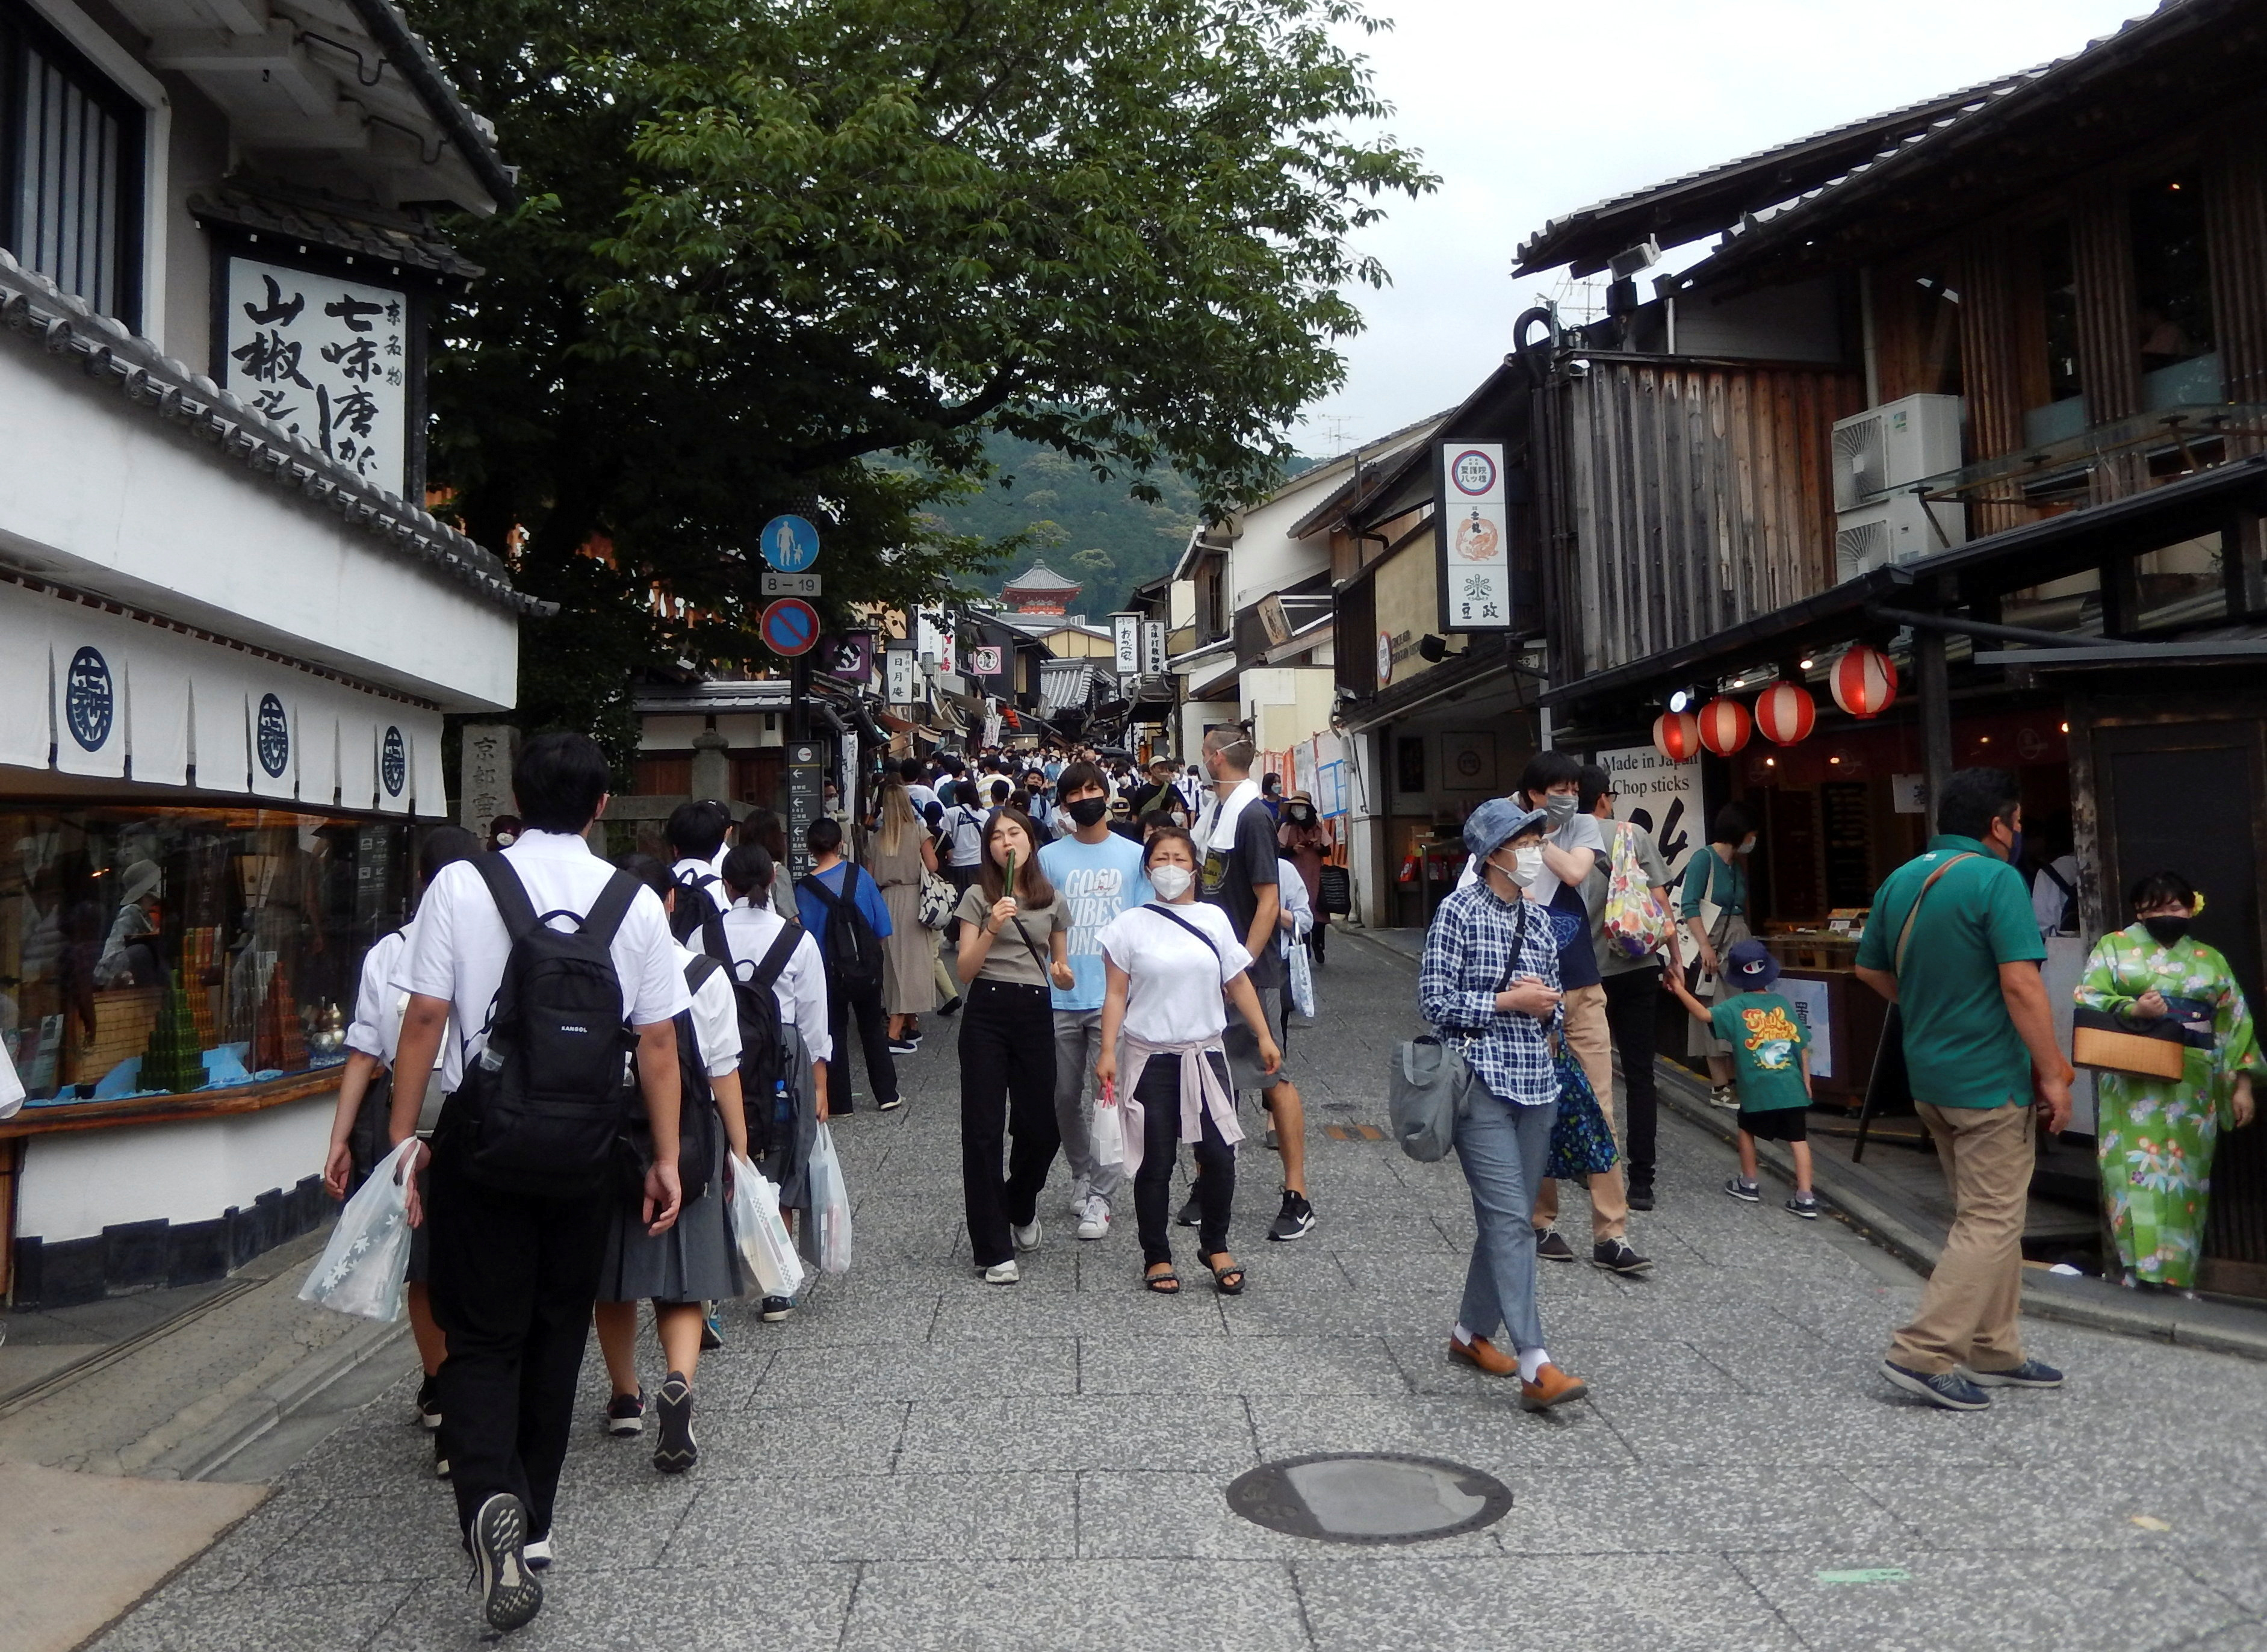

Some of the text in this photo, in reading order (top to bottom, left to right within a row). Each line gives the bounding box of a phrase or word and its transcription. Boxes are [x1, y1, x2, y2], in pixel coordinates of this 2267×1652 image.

[1462, 602, 1499, 619] 豆政
[892, 657, 905, 697] 日月庵
[1604, 753, 1699, 771] Made in Jan
[1613, 775, 1690, 797] Chop sticks
[1064, 868, 1122, 898] GOOD
[1067, 927, 1103, 955] ONL
